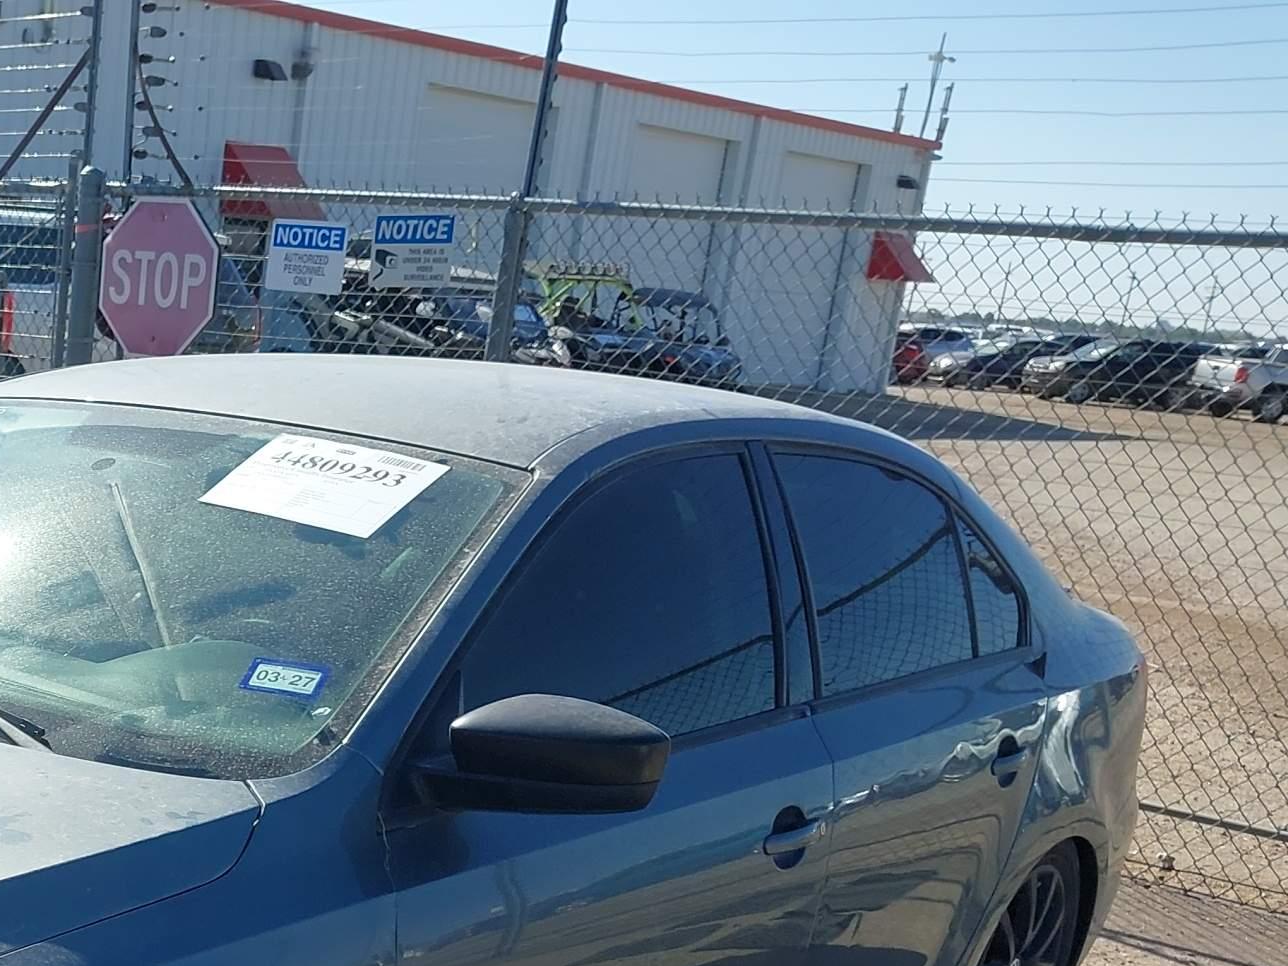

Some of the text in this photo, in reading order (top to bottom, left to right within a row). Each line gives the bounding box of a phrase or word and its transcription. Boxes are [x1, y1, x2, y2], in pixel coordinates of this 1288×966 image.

[276, 226, 342, 248] NOTICE
[377, 218, 451, 241] NOTICE
[283, 252, 329, 265] AUTHORIZED
[108, 249, 207, 310] STOP
[282, 264, 326, 276] PERSONNEL
[293, 275, 313, 286] ONLY
[271, 450, 408, 488] 44809293
